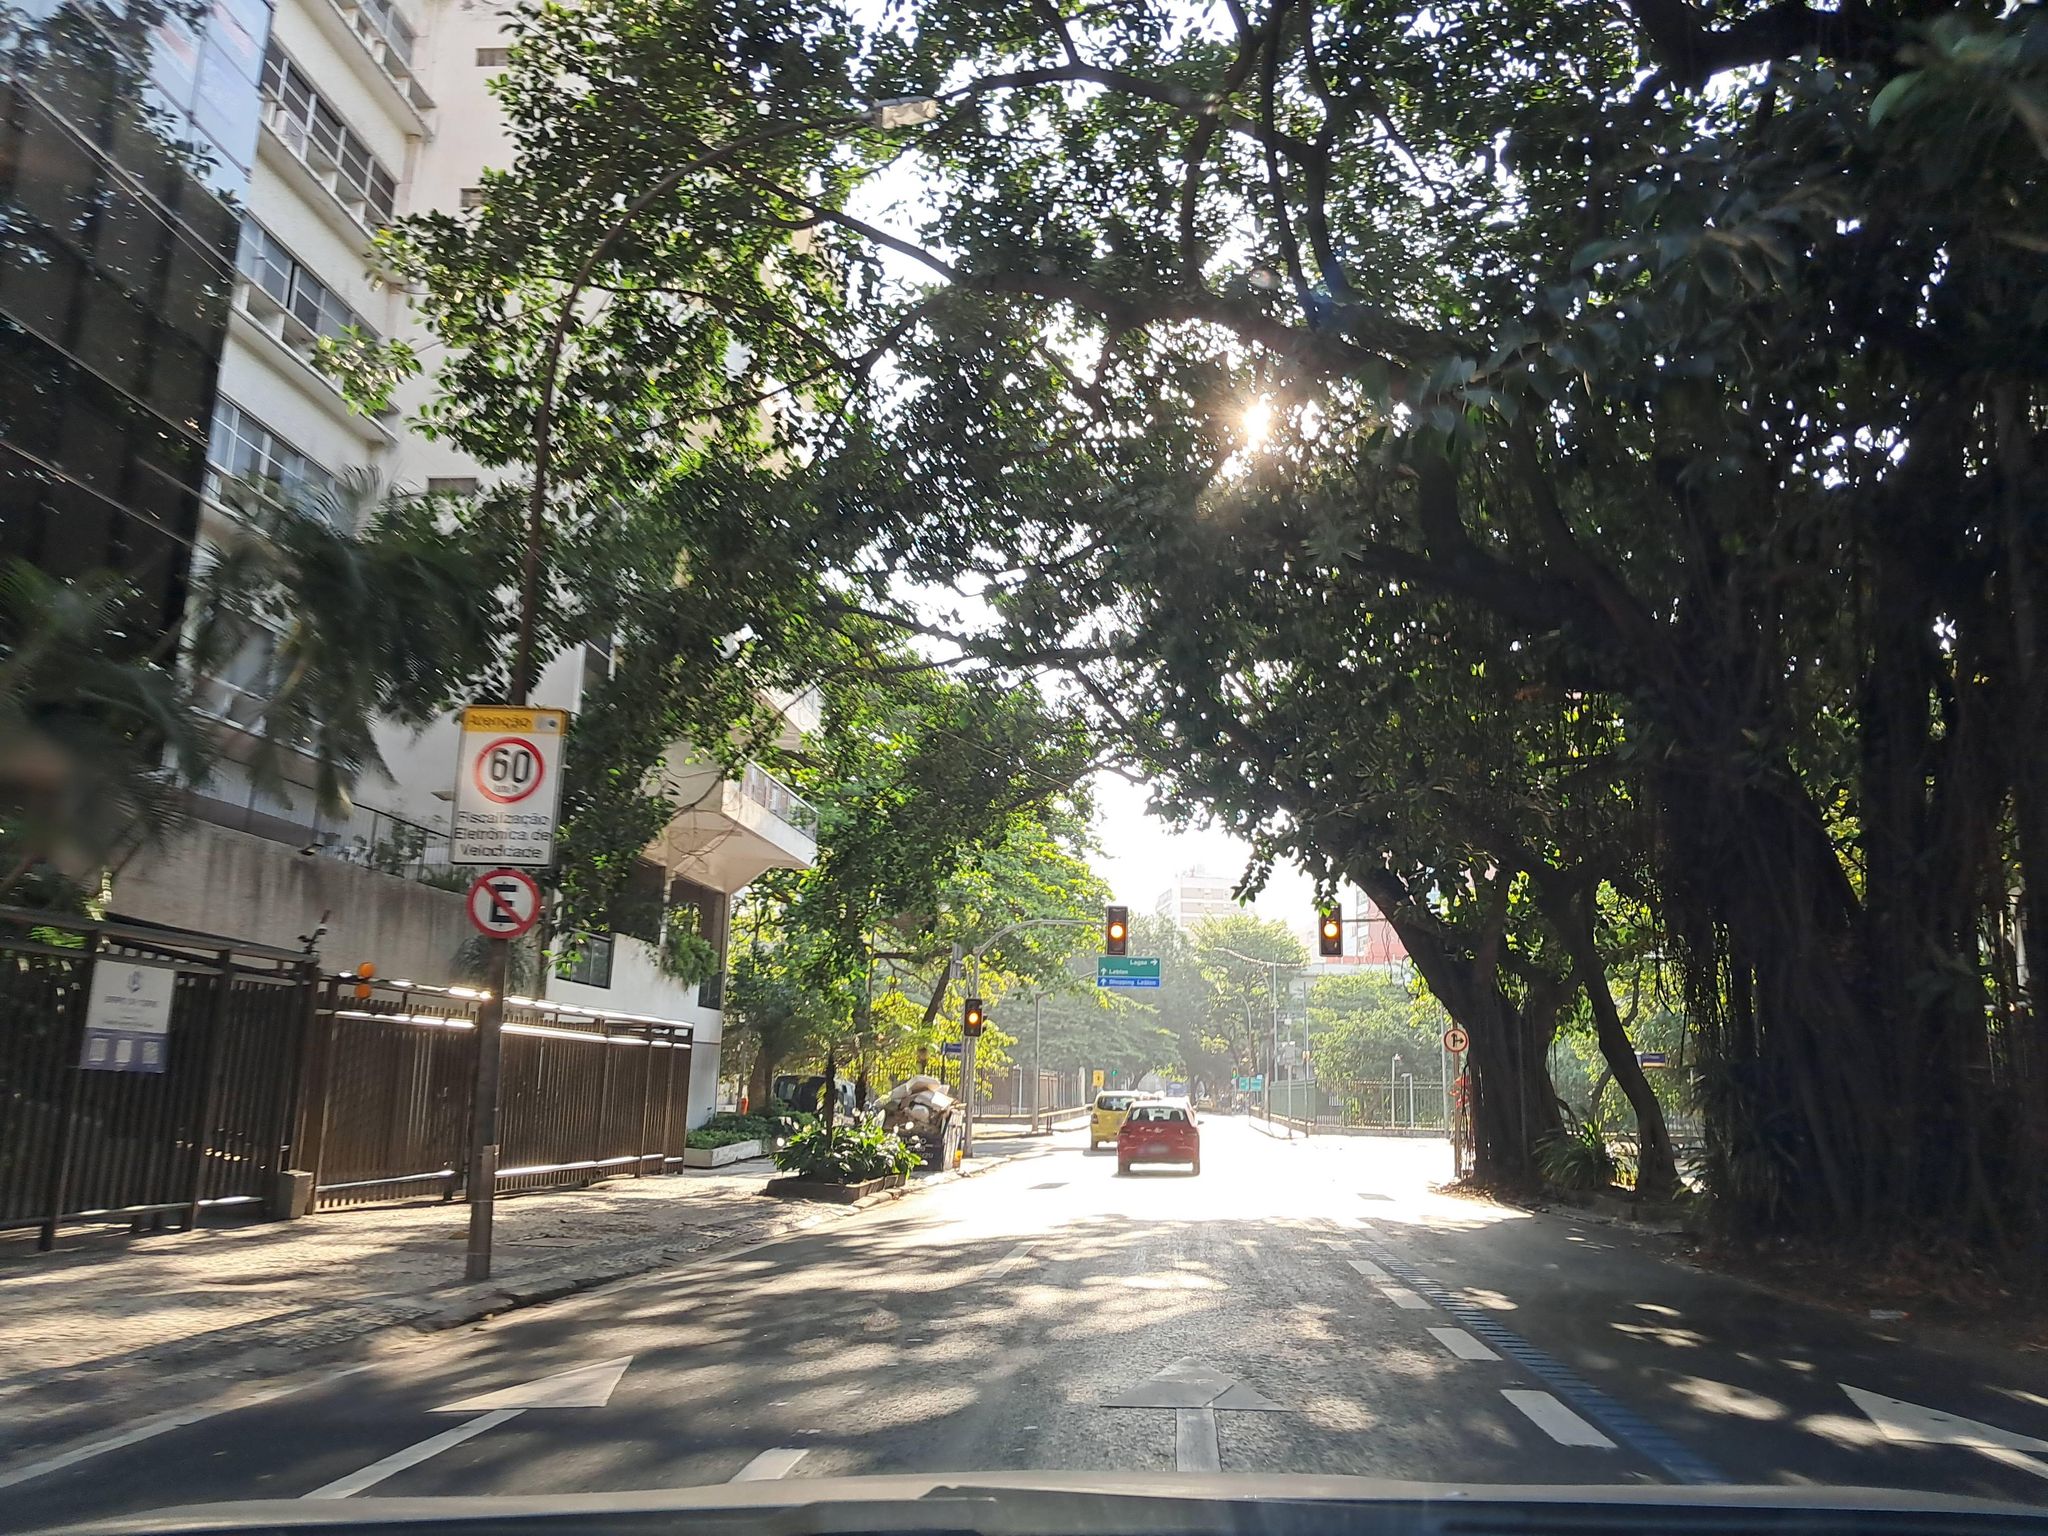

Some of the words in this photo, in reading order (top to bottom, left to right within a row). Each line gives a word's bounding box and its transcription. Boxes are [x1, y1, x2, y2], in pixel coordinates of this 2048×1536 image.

[491, 748, 531, 783] 60
[457, 810, 550, 827] Fiscalização
[454, 827, 528, 841] Eletrônica
[530, 828, 553, 842] de
[460, 843, 543, 859] Velocidade
[490, 883, 518, 923] E
